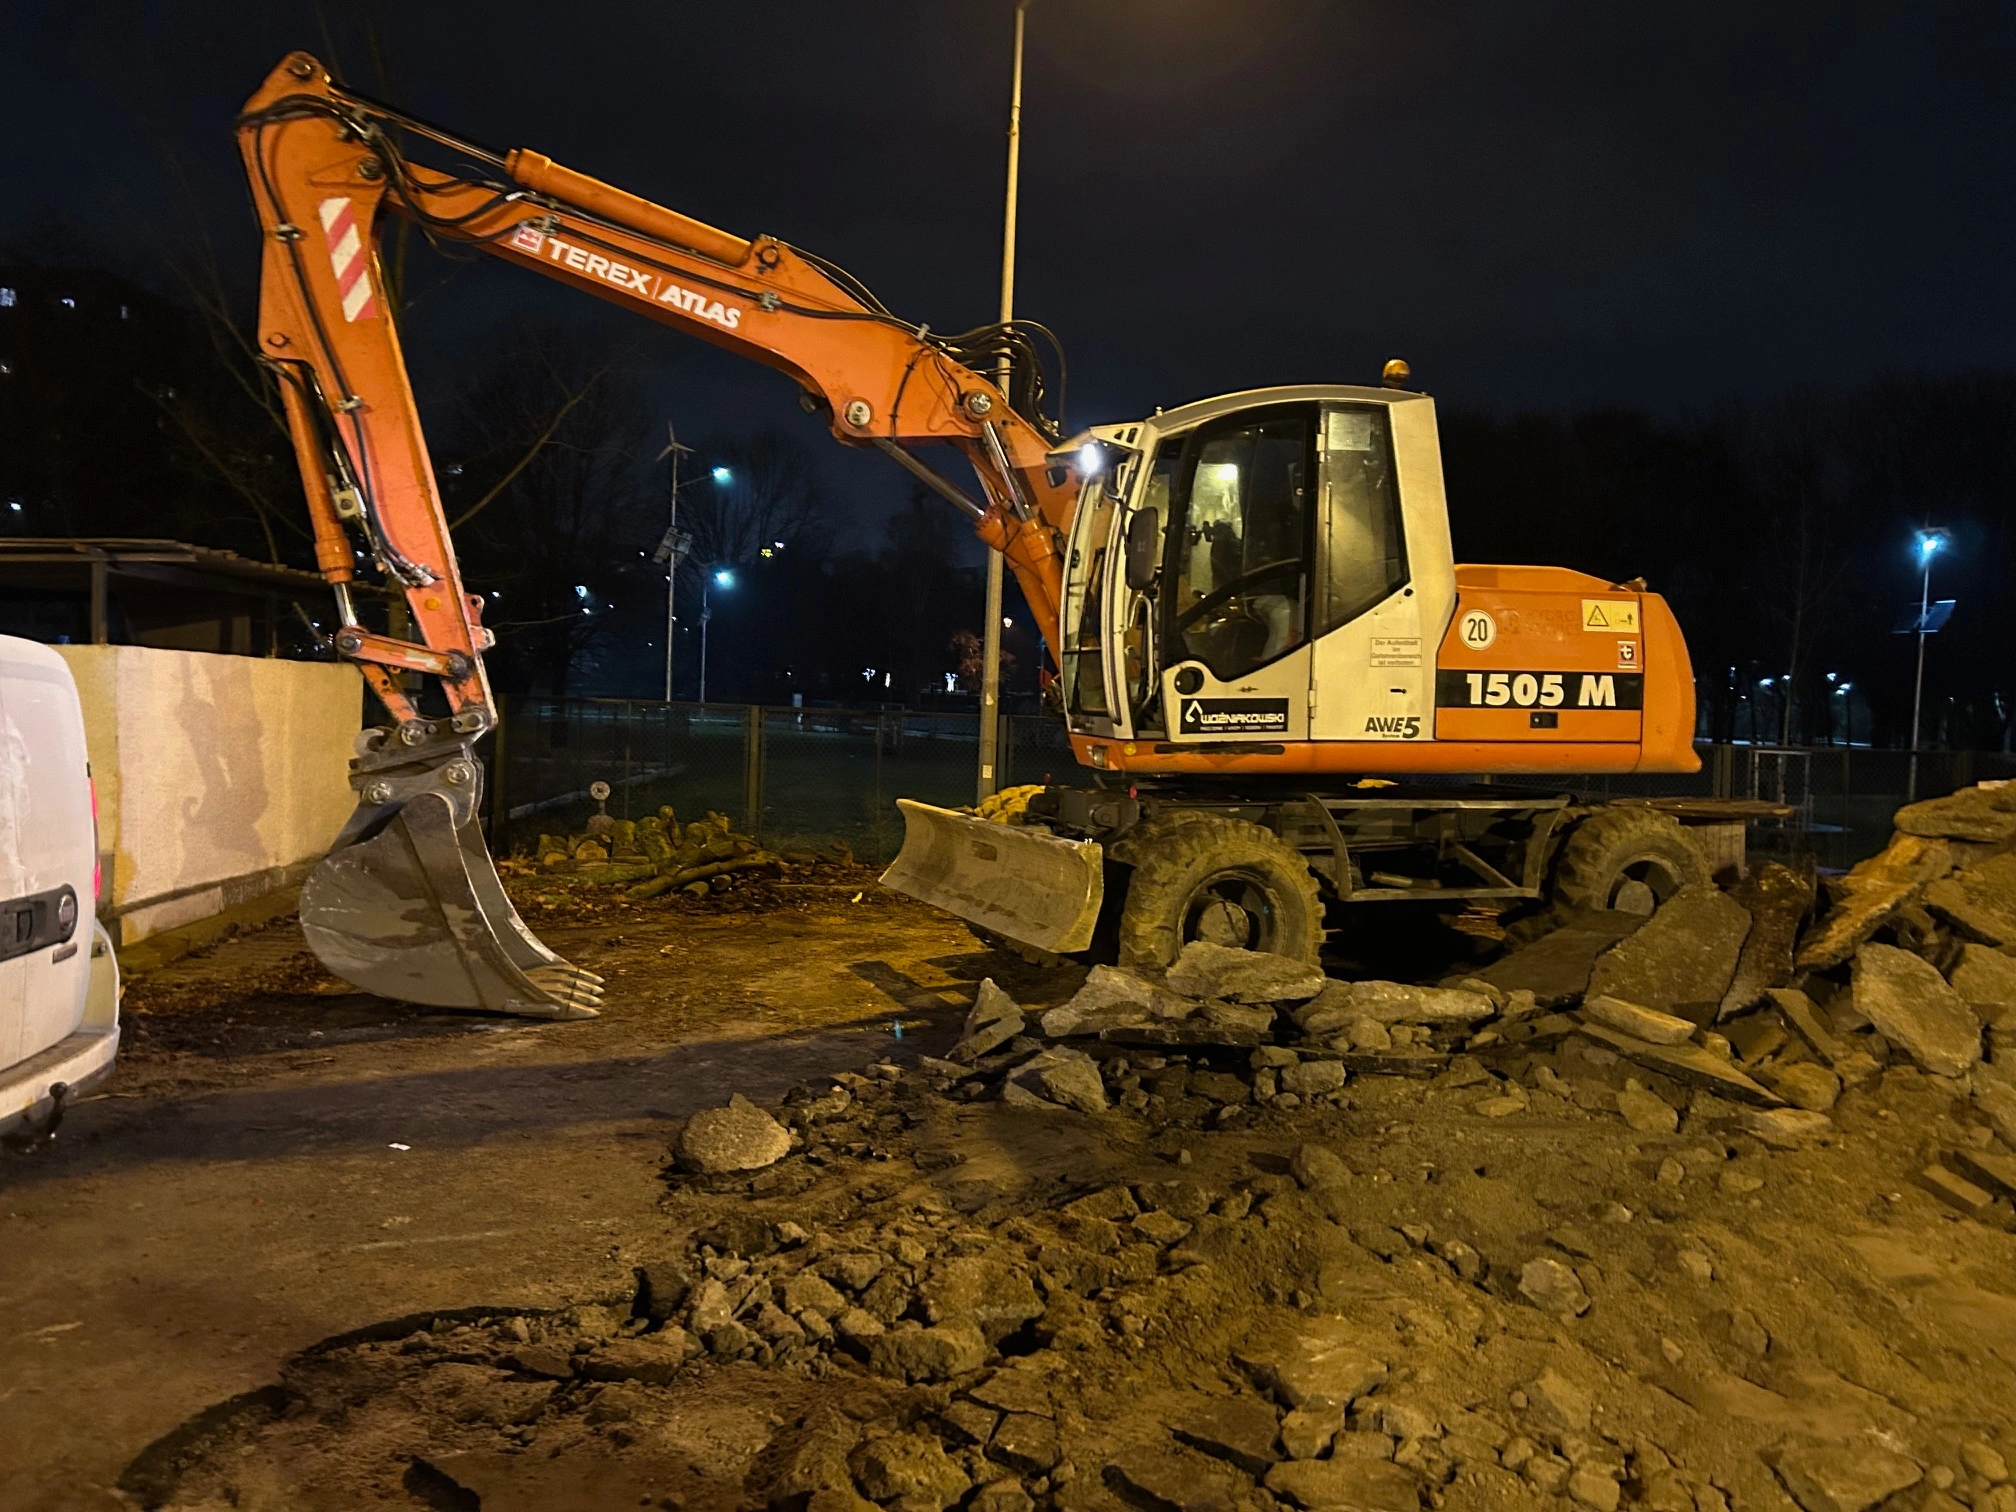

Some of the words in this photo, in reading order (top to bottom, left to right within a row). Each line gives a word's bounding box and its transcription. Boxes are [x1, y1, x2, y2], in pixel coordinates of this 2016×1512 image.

[547, 238, 652, 294] TEREX
[659, 285, 741, 328] ATLAS
[1467, 618, 1488, 642] 20
[1466, 673, 1565, 706] 1505
[1578, 675, 1616, 706] M
